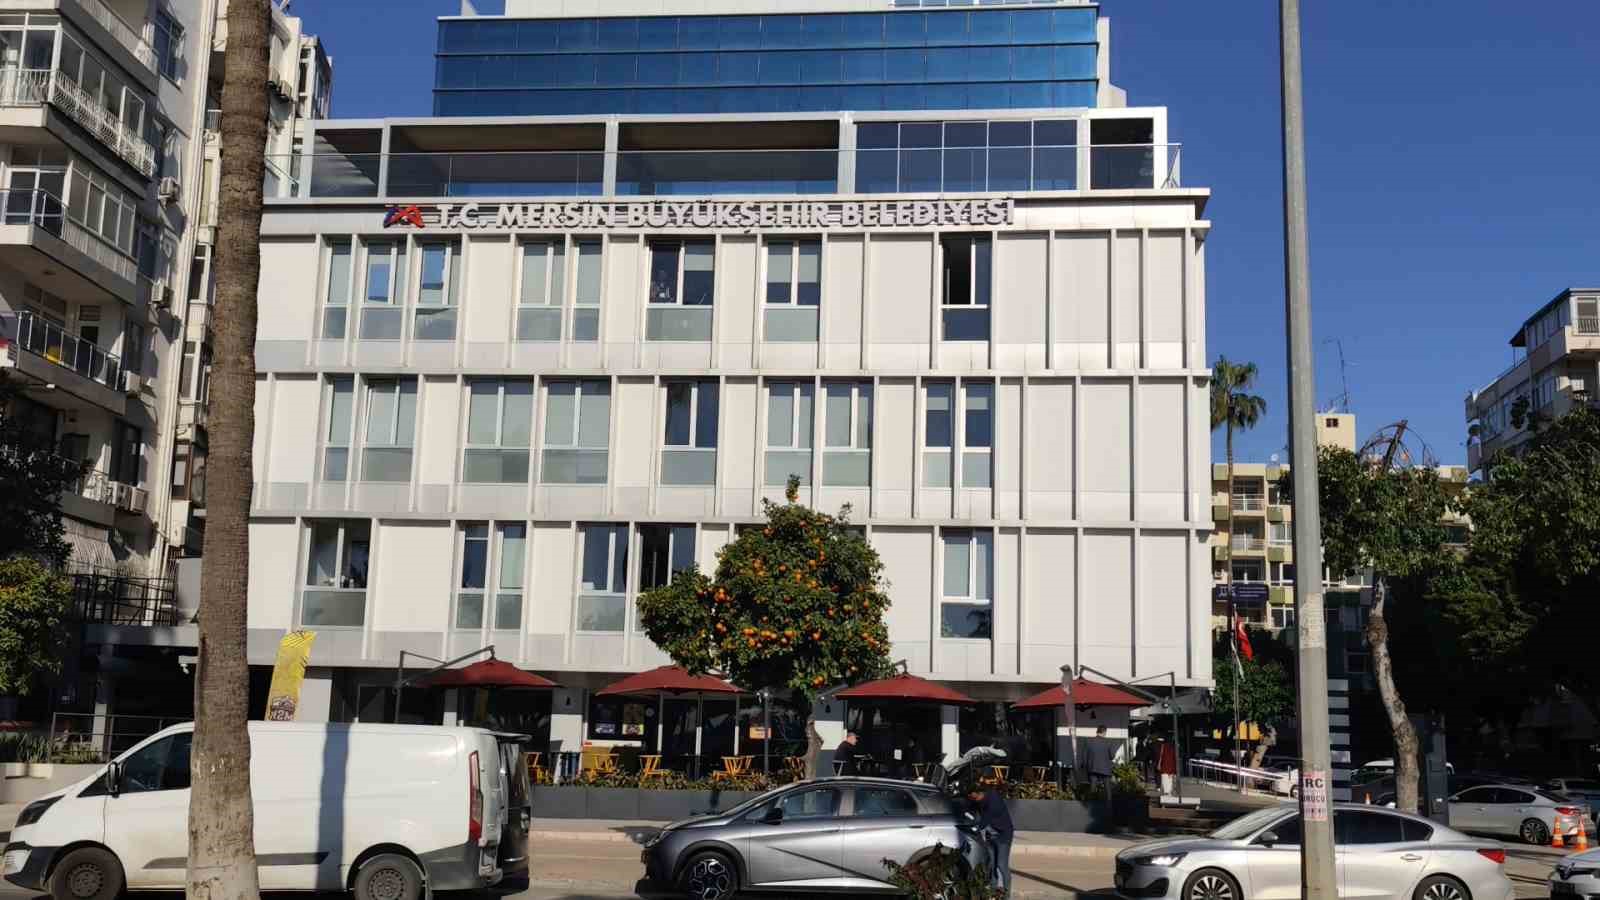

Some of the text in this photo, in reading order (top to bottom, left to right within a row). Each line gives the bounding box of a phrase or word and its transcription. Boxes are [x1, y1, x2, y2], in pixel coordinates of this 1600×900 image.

[437, 195, 1015, 233] T.C. MERSİN BÜYÜKŞEHİR BELEDİYESİ
